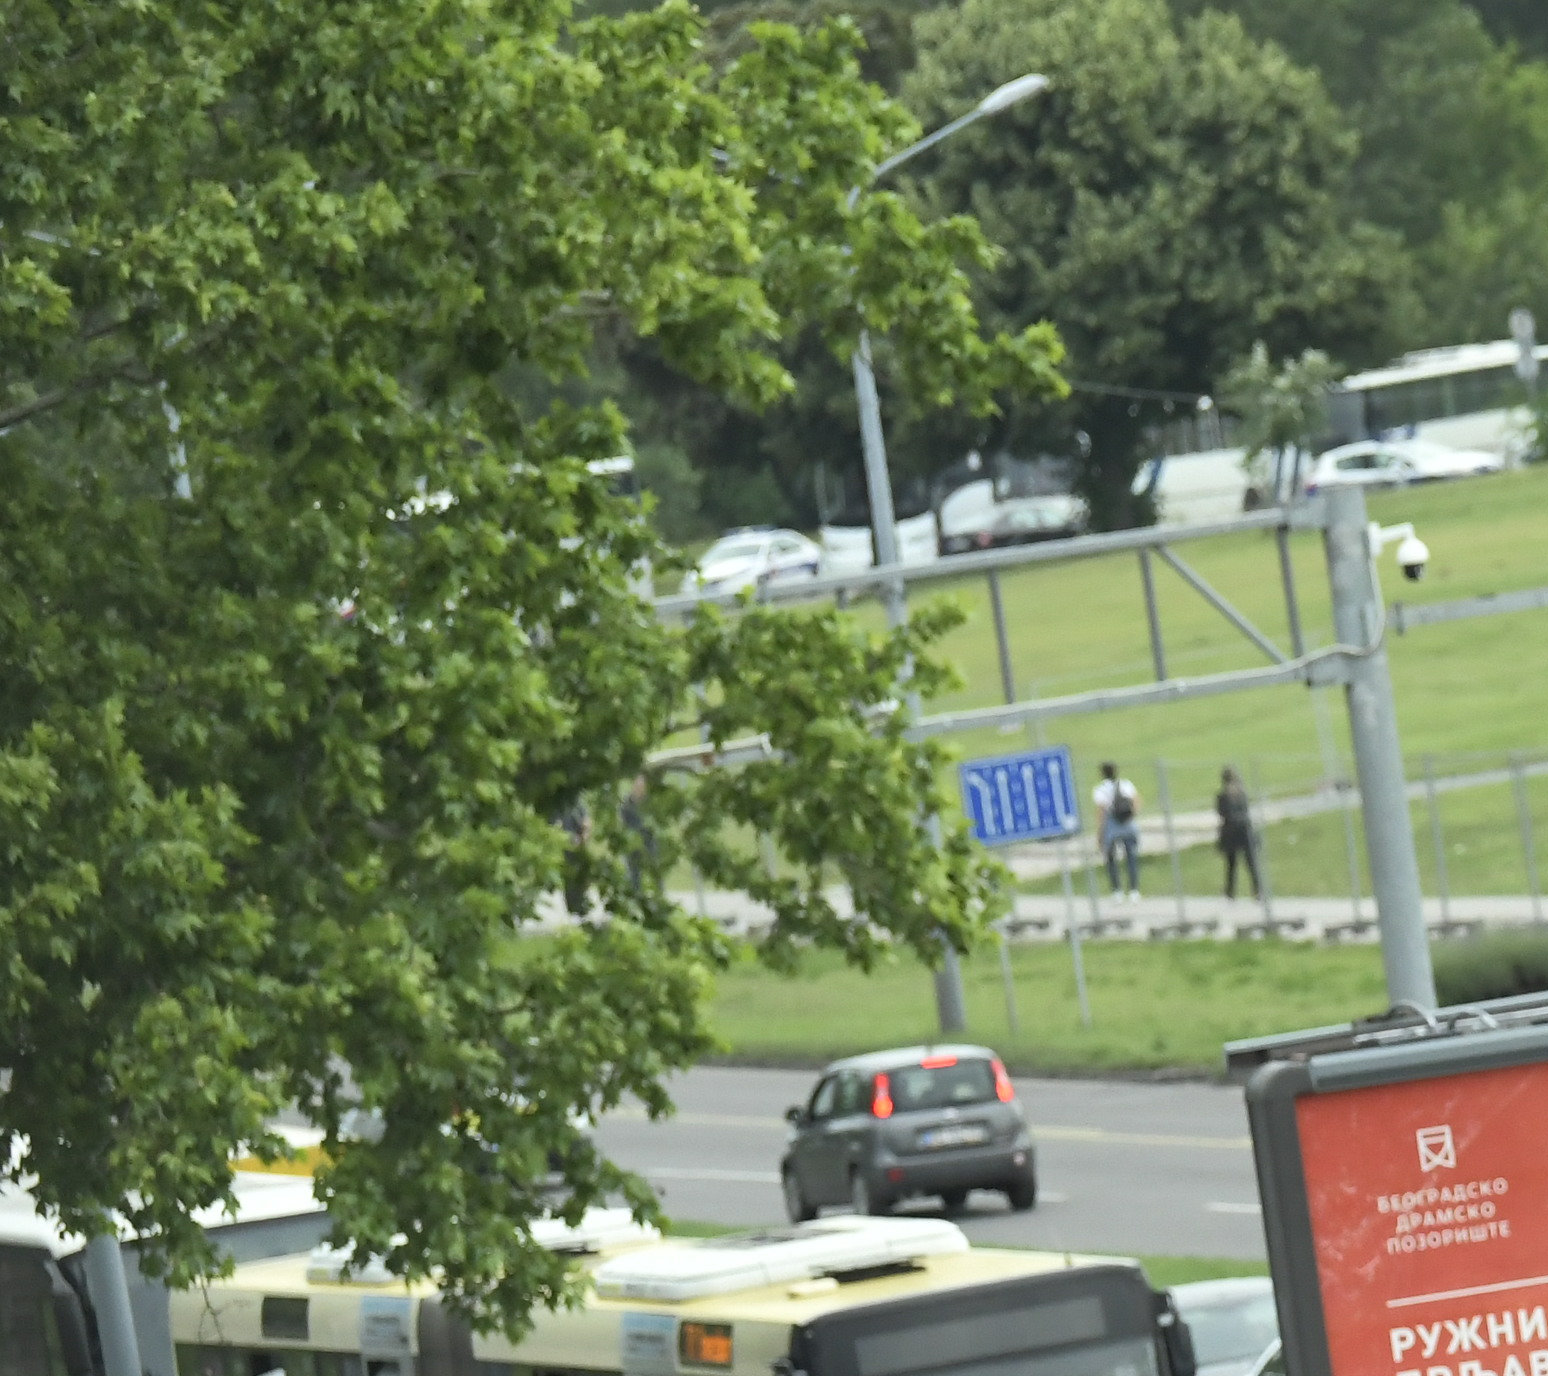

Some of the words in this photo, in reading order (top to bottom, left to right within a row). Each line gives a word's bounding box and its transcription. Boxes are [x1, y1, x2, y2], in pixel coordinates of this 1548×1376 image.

[1377, 1177, 1509, 1214] БЕОГРАДСКО
[1396, 1201, 1496, 1235] ДРАМСКО
[1387, 1220, 1512, 1255] ПОЗОРИШТЕ
